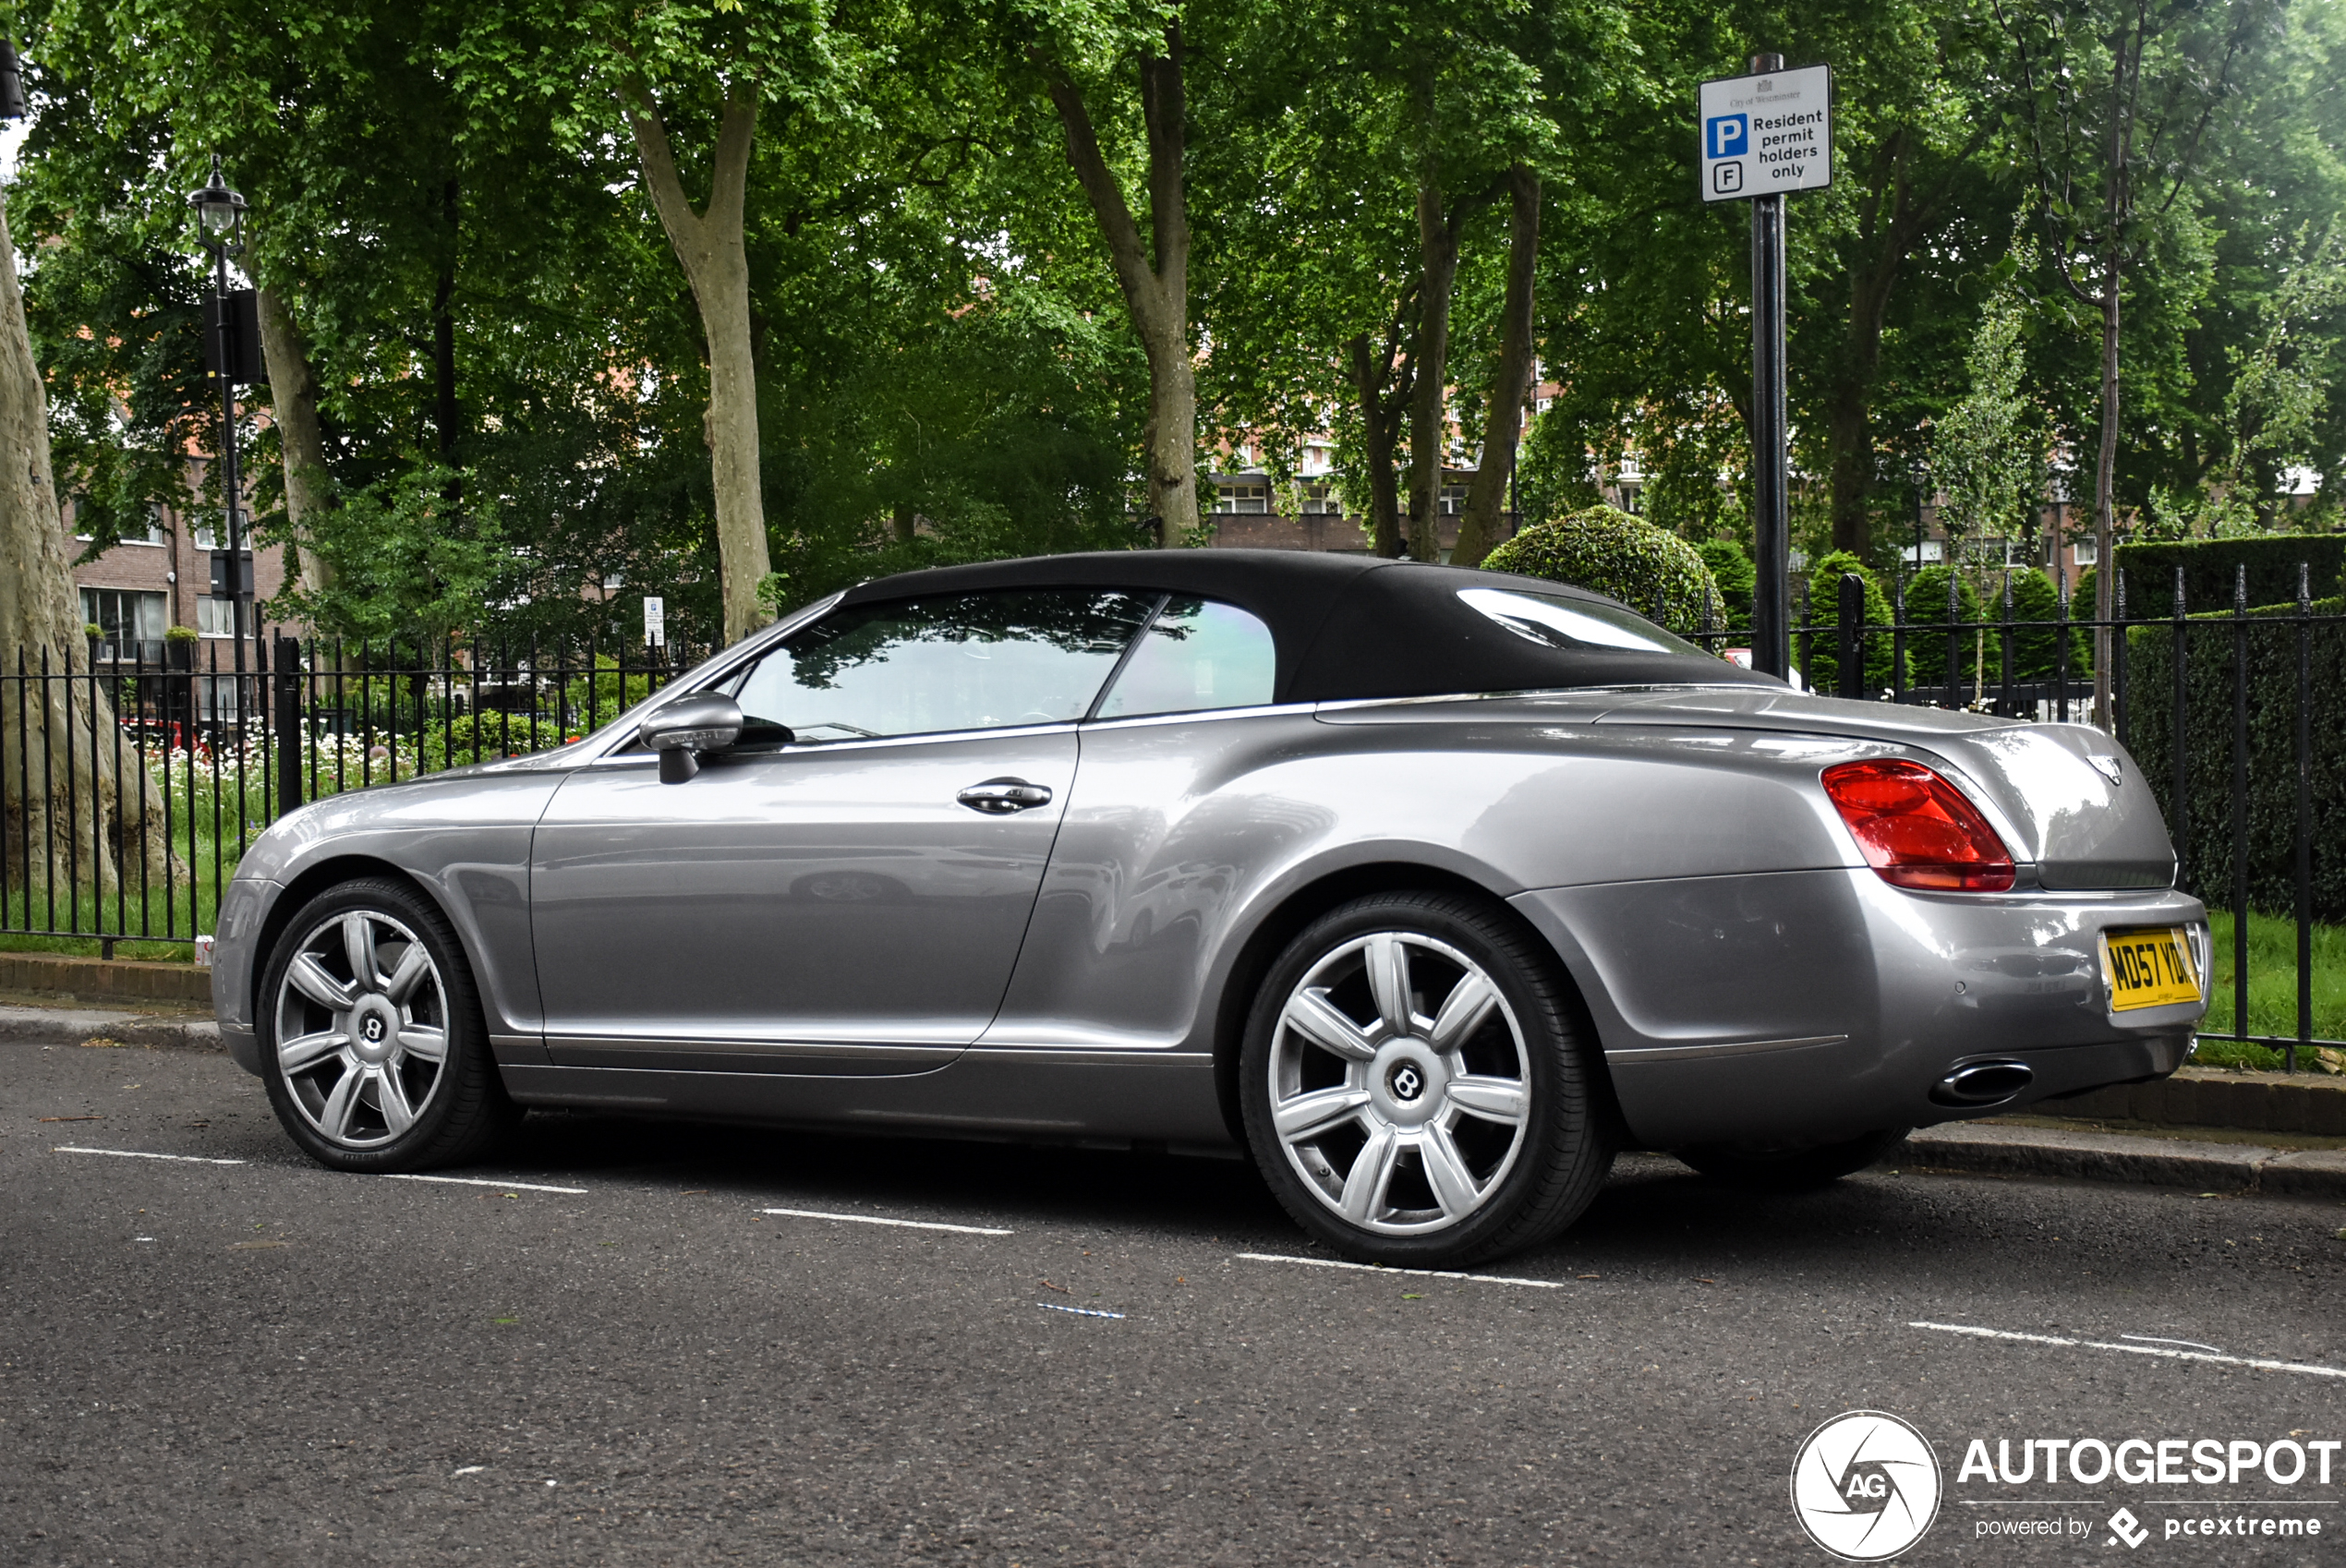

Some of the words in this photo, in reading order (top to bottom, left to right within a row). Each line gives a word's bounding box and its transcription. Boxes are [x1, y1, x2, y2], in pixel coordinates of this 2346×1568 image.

[1729, 98, 1745, 109] City
[1746, 96, 1754, 105] of
[1756, 91, 1801, 103] Westminster
[1754, 110, 1822, 131] Resident
[1716, 119, 1742, 155] P
[1762, 128, 1814, 149] permit
[1760, 147, 1818, 163] holders
[1723, 169, 1734, 186] F
[1772, 163, 1805, 178] only
[2109, 944, 2161, 991] MD57
